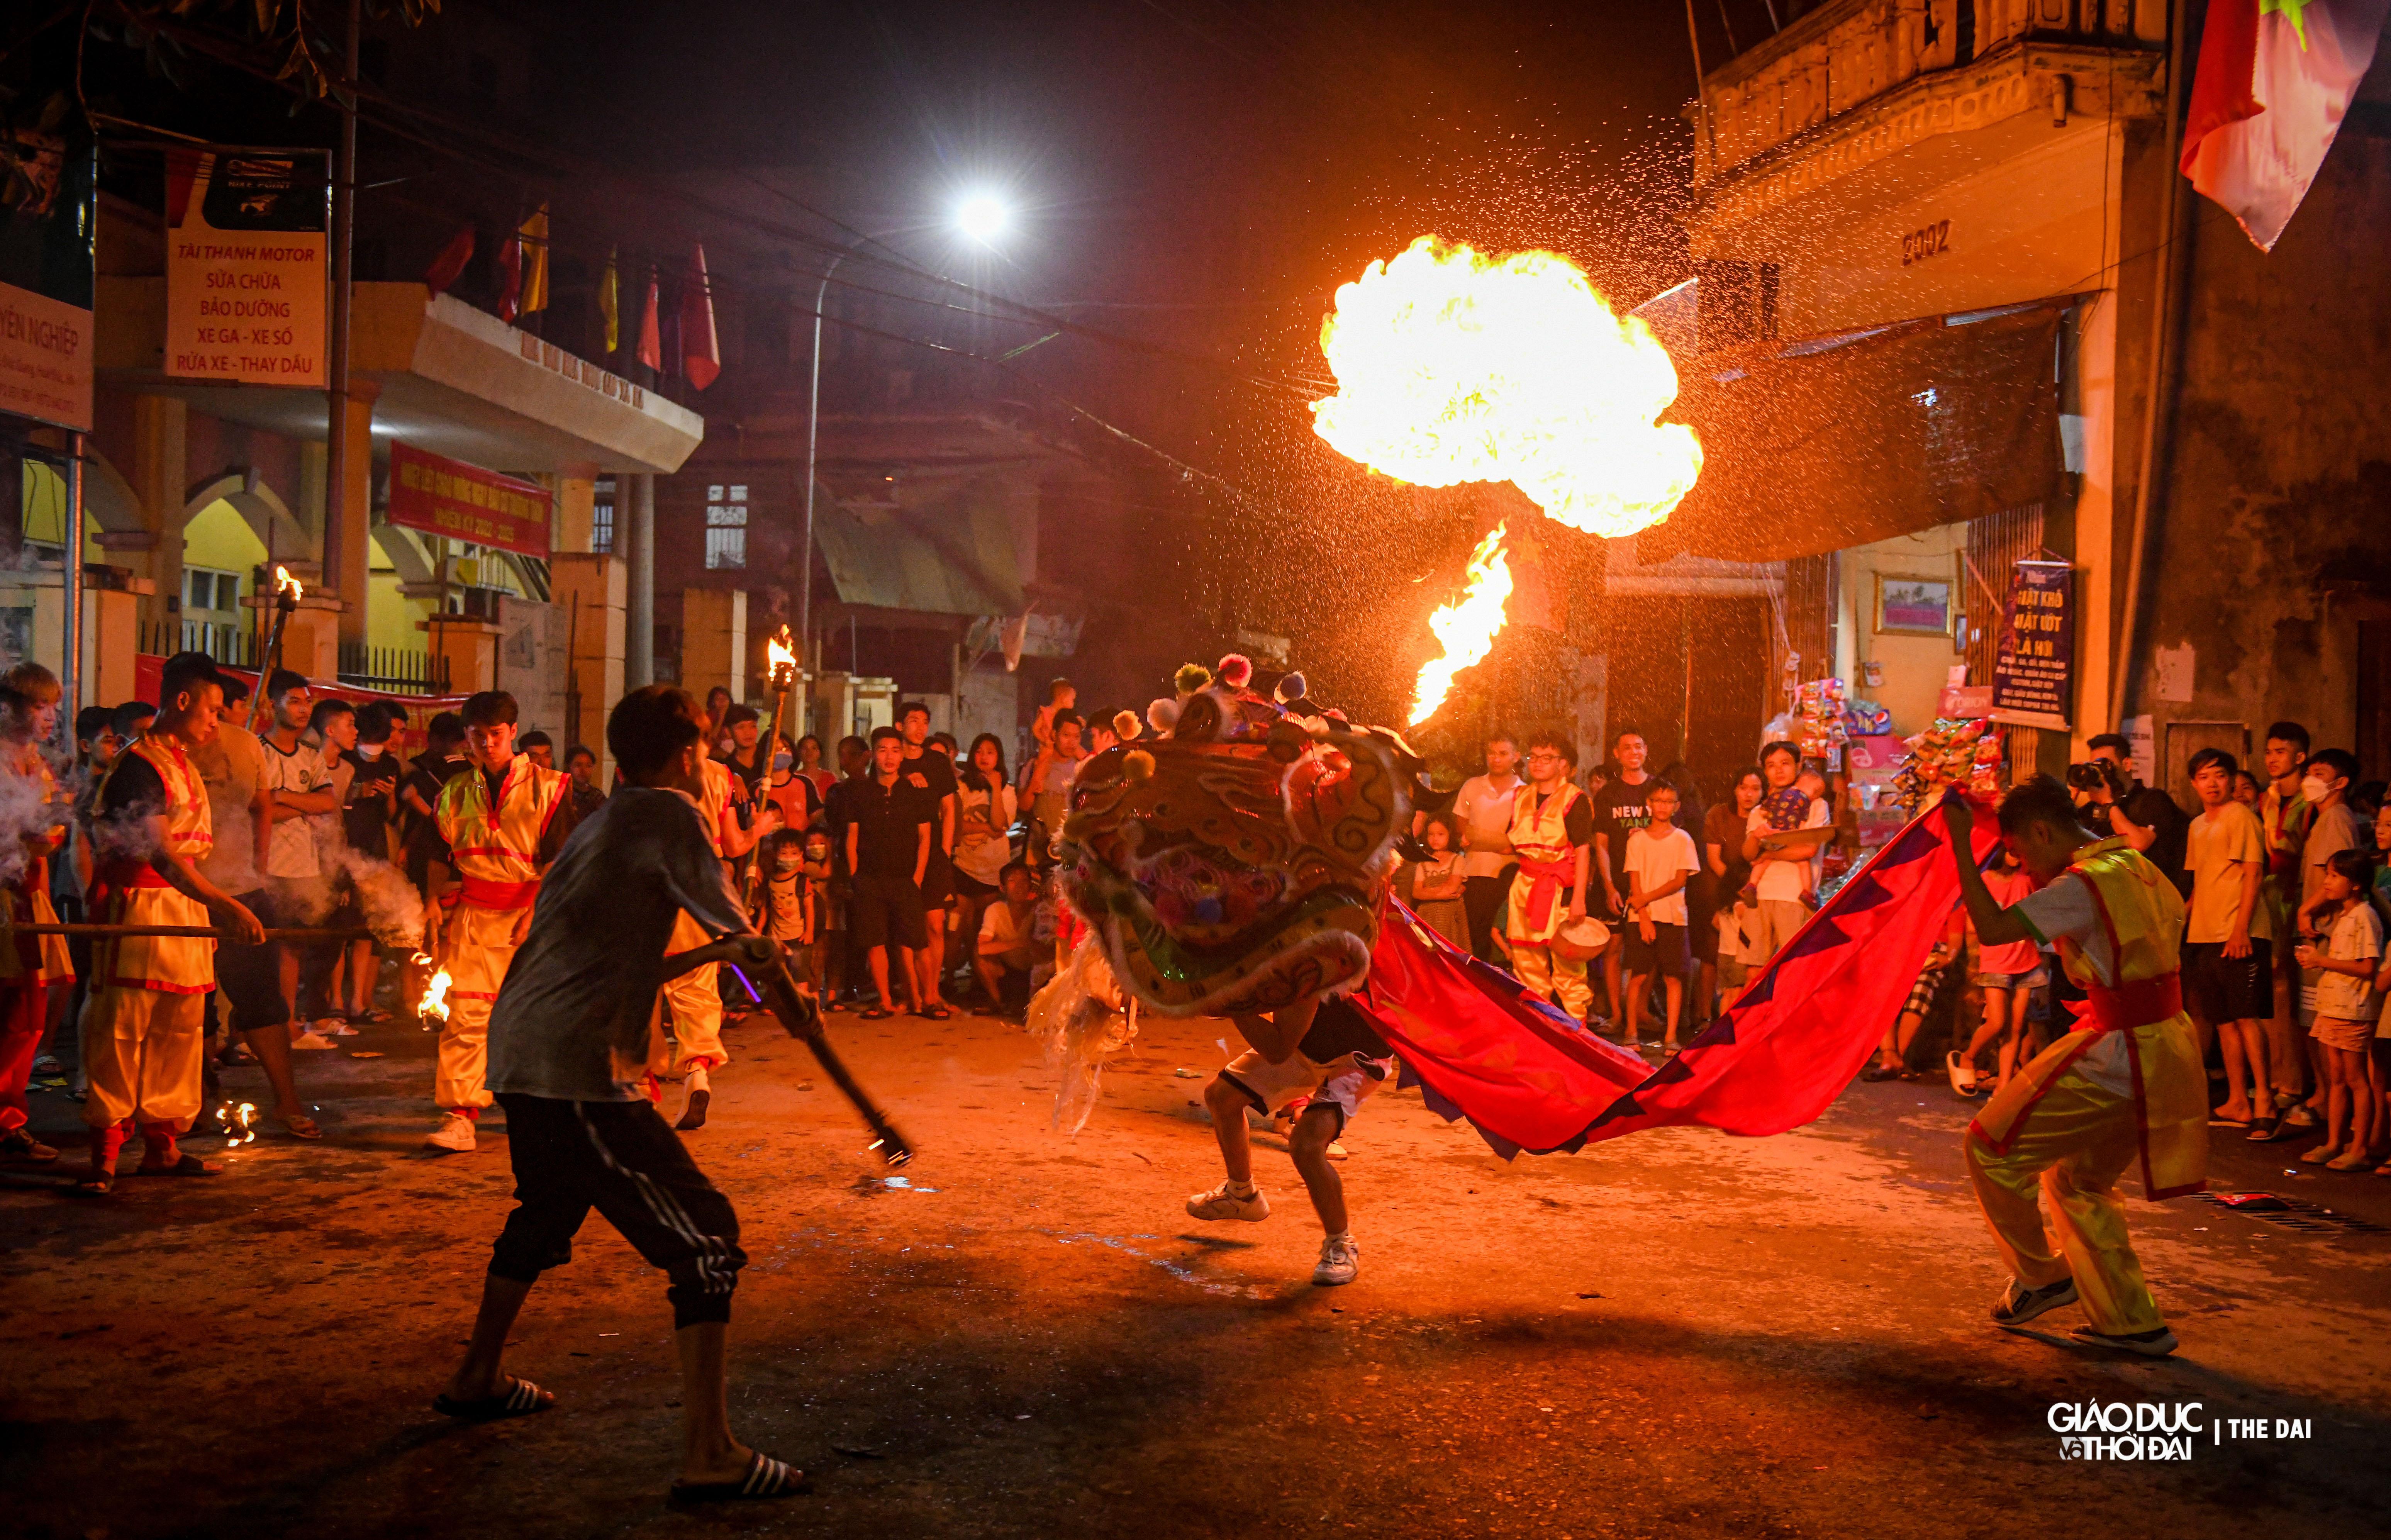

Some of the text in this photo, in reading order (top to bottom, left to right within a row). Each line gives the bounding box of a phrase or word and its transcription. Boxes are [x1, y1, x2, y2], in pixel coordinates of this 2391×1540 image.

[179, 243, 314, 261] TÀI THANH MOTOR
[1903, 219, 1950, 266] 2002
[207, 269, 281, 290] SỬA CHỮA
[201, 297, 290, 317] BẢO DƯỠNG
[197, 328, 215, 343] XE
[219, 329, 239, 344] GA
[252, 329, 269, 344] XE
[273, 326, 293, 345] SỐ
[177, 352, 207, 370] RỬA
[210, 356, 229, 371] XE
[240, 357, 277, 372] THAY
[1612, 806, 1643, 819] NEW
[1620, 818, 1652, 828] YANK
